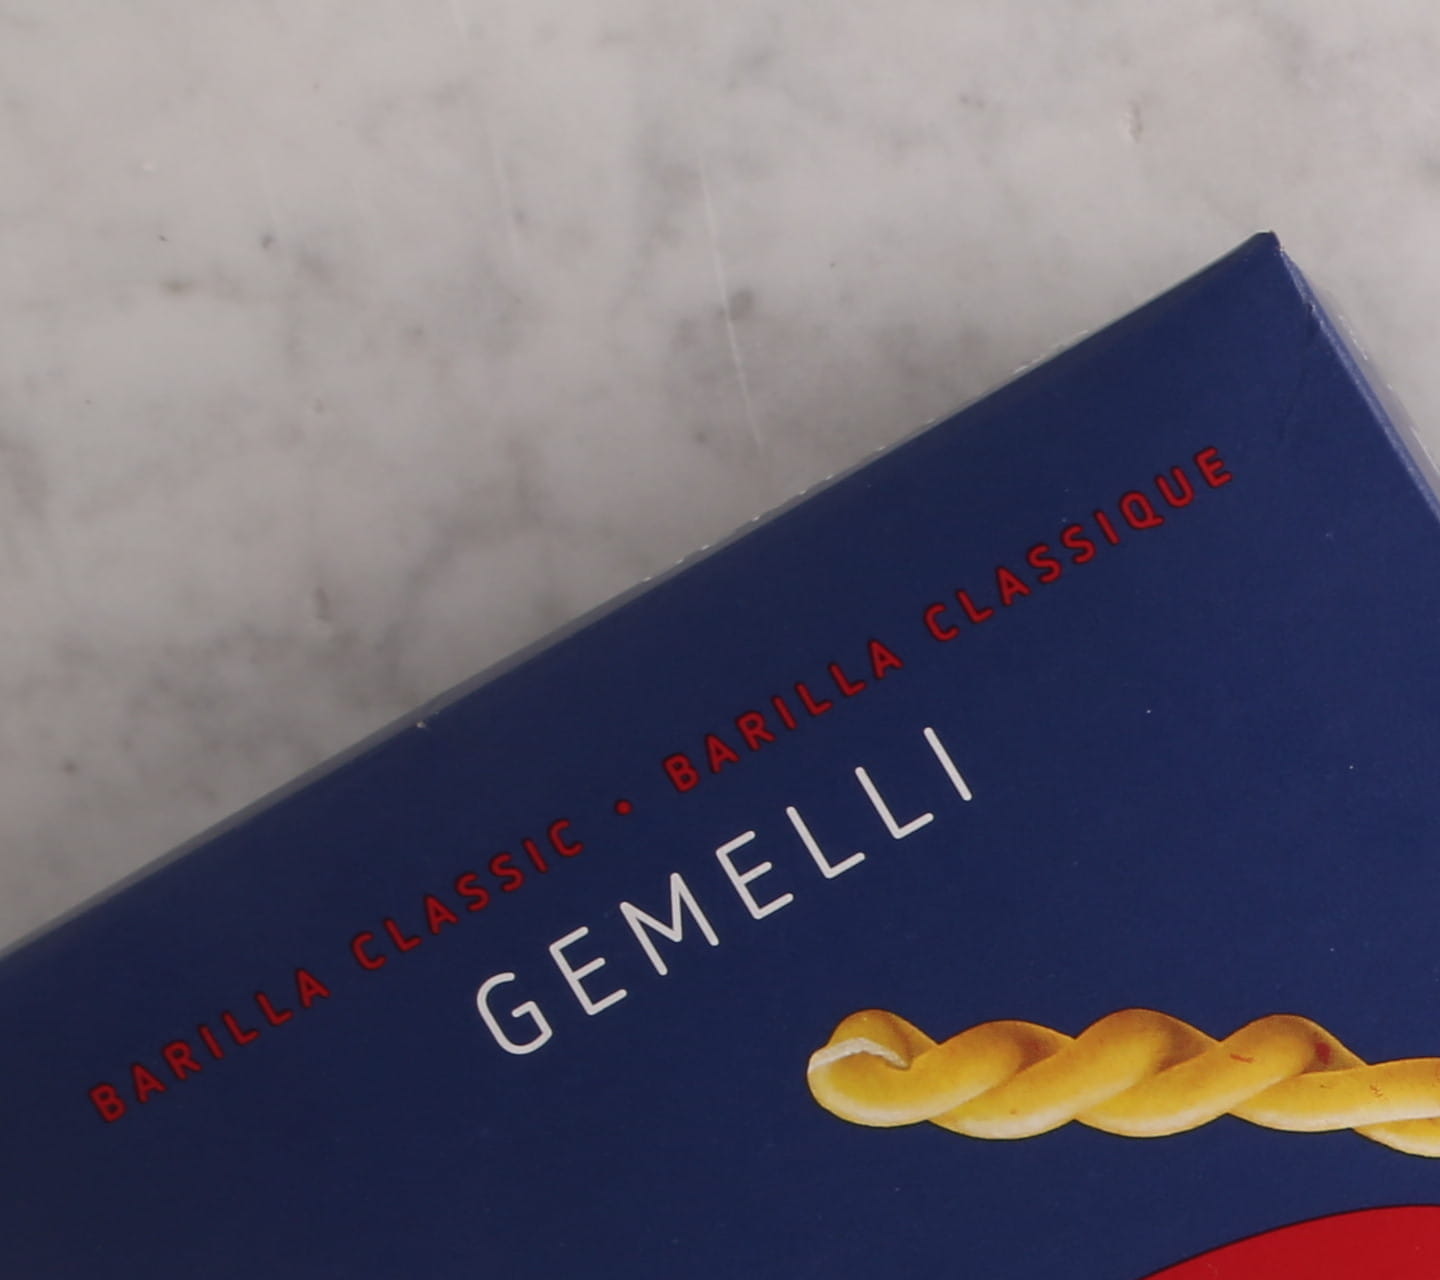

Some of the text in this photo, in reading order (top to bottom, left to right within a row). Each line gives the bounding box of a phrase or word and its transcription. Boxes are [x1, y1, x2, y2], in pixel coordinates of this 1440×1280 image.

[91, 448, 1231, 1121] BARILLA CLASSIC BARILLA CLASSIQUE
[477, 727, 972, 1054] GEMELLI
